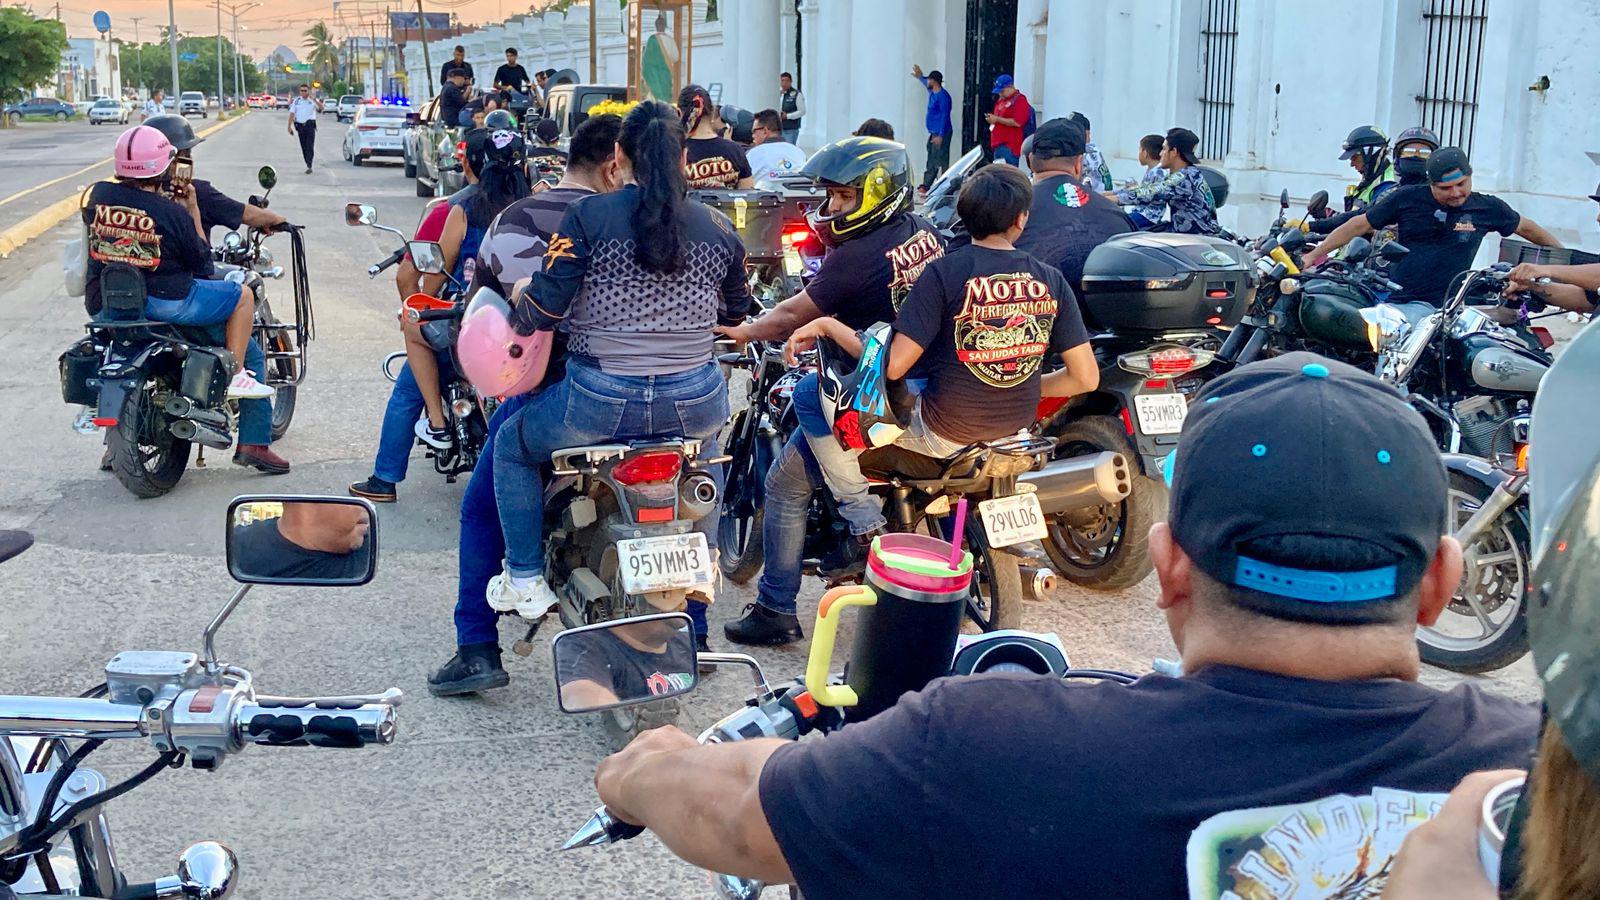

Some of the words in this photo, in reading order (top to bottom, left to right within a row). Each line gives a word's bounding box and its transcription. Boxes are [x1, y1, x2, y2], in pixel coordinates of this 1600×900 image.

[90, 204, 155, 231] MOTO
[885, 231, 938, 288] MOTO
[953, 276, 1048, 321] MOTO
[968, 352, 990, 361] SAN
[991, 347, 1020, 360] JUDAS
[1020, 344, 1045, 355] TADEO
[1141, 404, 1184, 422] 55VMR3
[629, 549, 700, 578] 95VMM3
